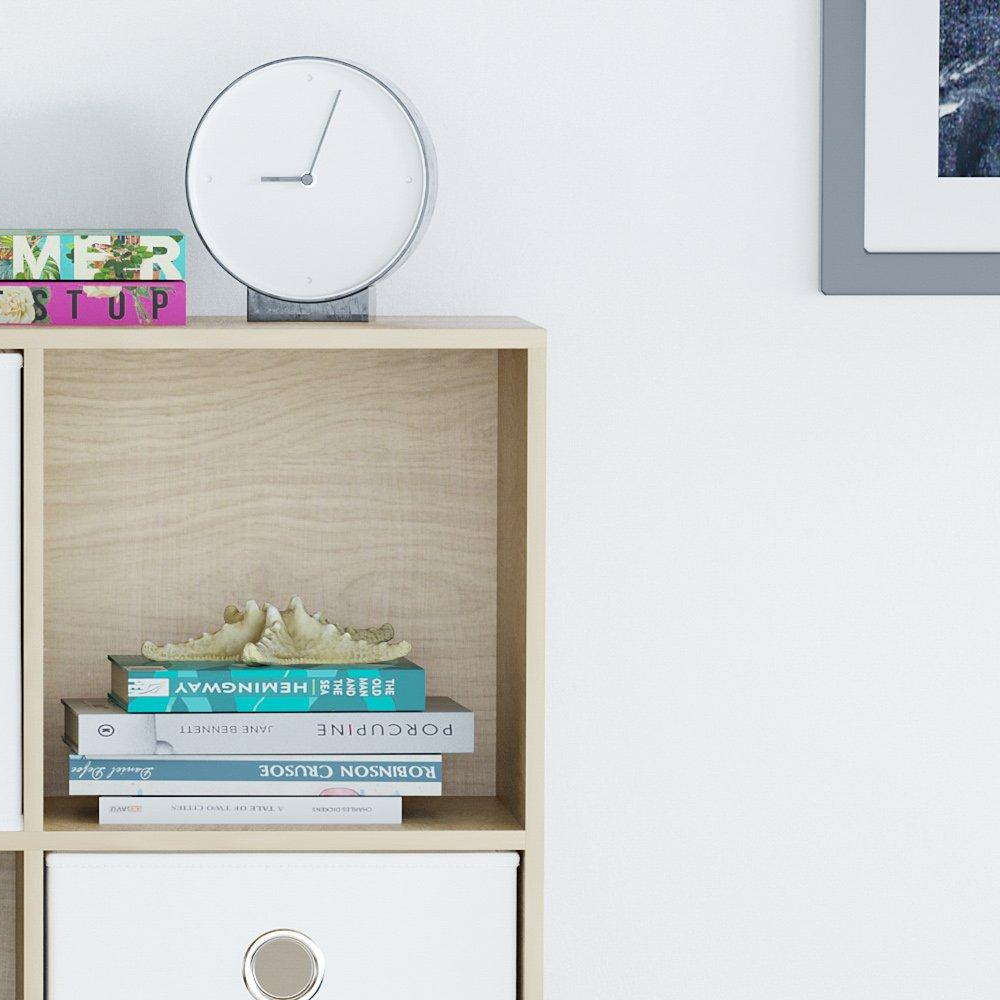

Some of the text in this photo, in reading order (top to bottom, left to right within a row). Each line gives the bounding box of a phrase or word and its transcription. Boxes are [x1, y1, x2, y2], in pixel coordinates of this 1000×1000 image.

[33, 288, 168, 321] STOP
[175, 681, 308, 695] HEMINGWAY
[319, 679, 329, 696] SEA
[332, 678, 342, 696] THE
[345, 677, 356, 697] AND
[359, 678, 369, 697] MAN
[372, 678, 381, 696] OLD
[385, 678, 395, 696] THE
[179, 724, 274, 735] JANE BENNETT
[317, 723, 453, 737] PORCUPINE
[107, 765, 154, 781] Daniel
[259, 764, 436, 780] ROBINSON CRUSOE
